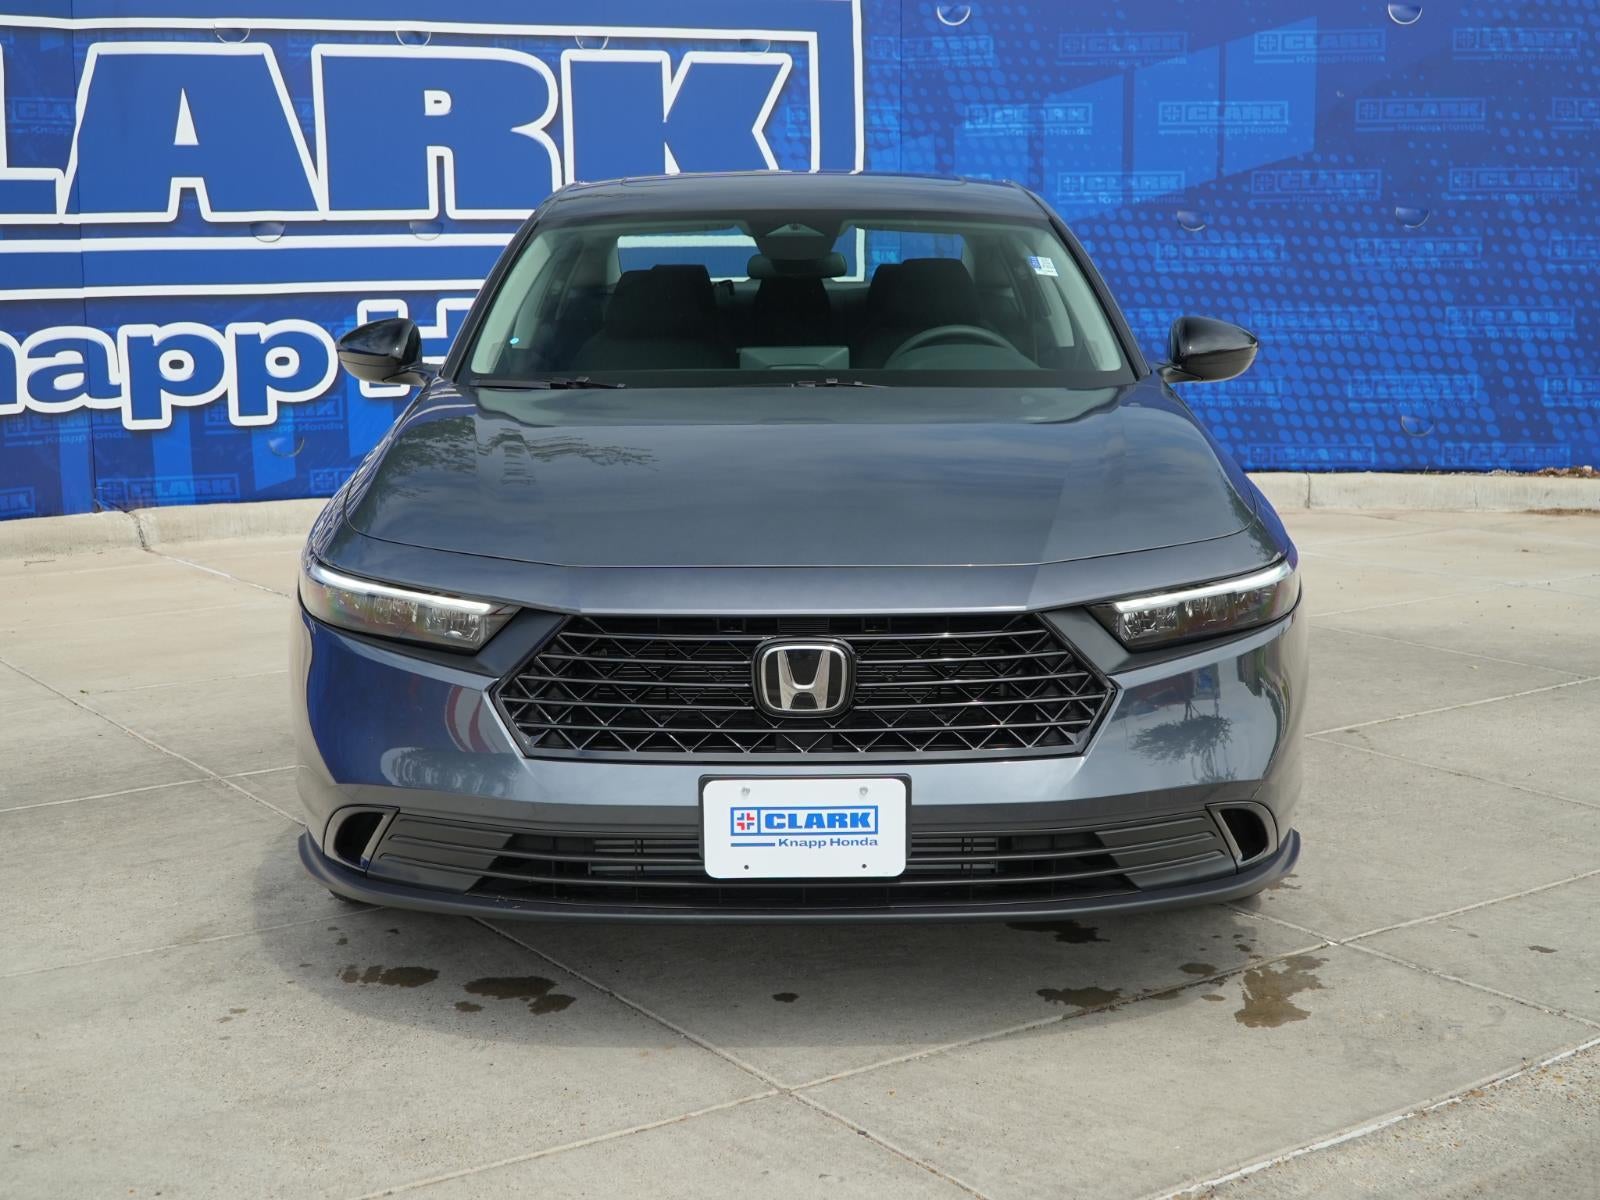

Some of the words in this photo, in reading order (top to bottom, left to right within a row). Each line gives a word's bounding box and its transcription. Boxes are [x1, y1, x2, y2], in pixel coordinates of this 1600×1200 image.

[1283, 33, 1378, 50] CLARK
[1187, 105, 1281, 121] CLARK
[1385, 102, 1479, 117] CLARK
[1244, 125, 1287, 135] Honda
[1086, 175, 1179, 191] CLARK
[130, 479, 231, 498] CLARK
[765, 812, 871, 829] CLARK
[778, 838, 827, 848] Knapp
[830, 837, 878, 847] Honda
